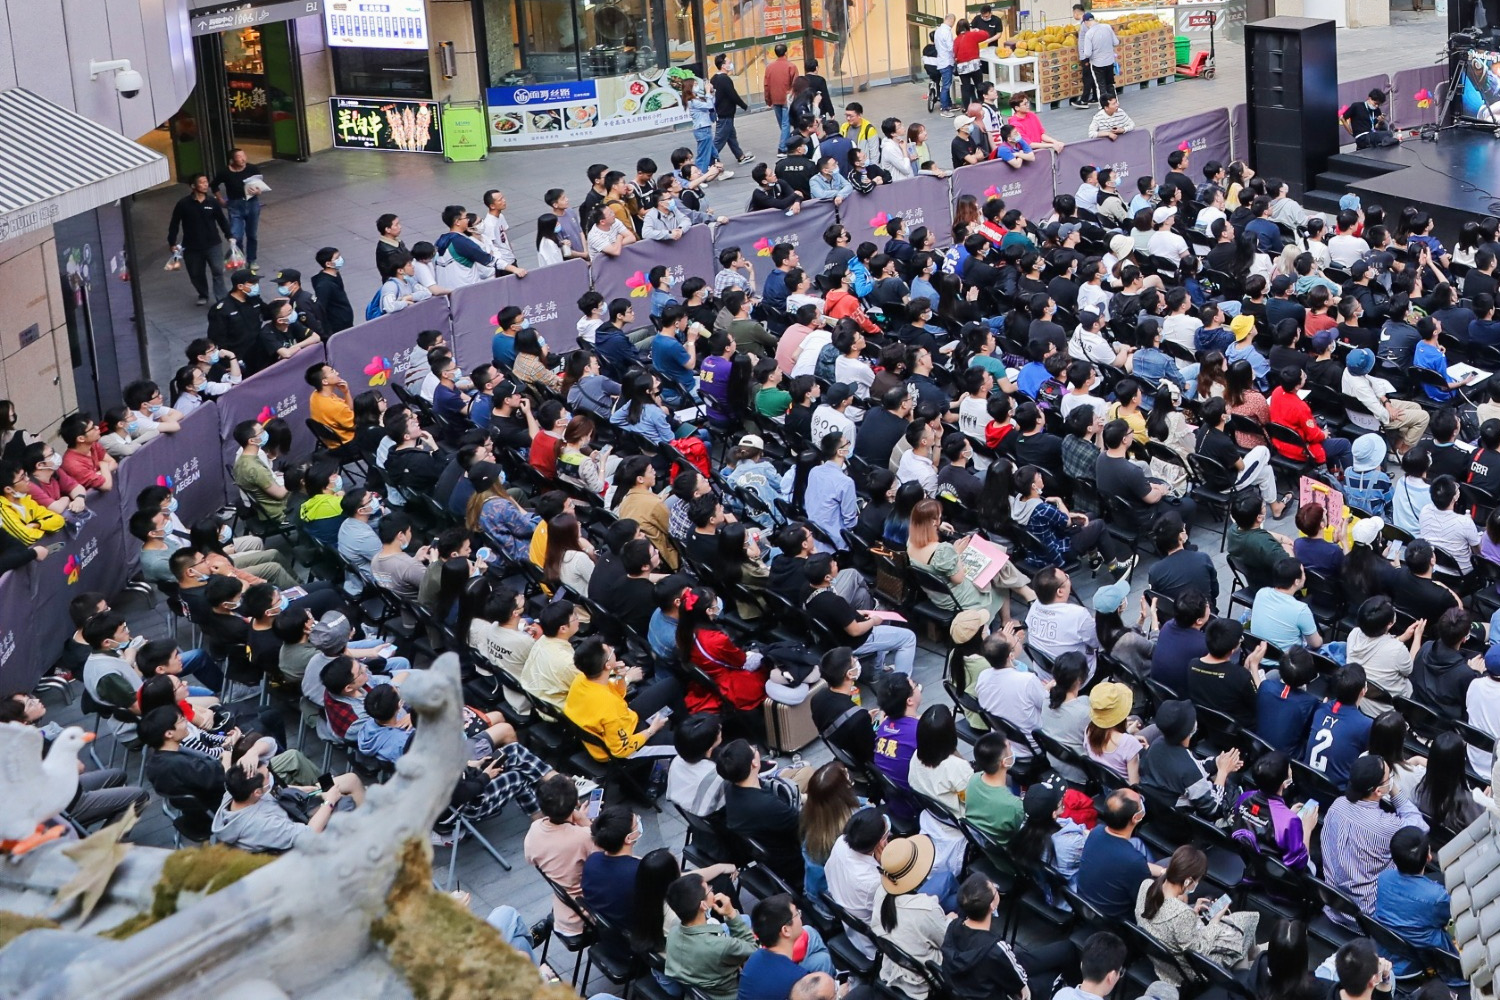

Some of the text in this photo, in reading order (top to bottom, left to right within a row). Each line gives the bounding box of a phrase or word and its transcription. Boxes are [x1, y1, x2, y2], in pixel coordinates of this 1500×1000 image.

[338, 109, 384, 147] 羊肉串
[1001, 181, 1021, 192] 爱琴海
[1002, 189, 1022, 198] AEGEAN
[276, 394, 297, 412] 爱琴海
[277, 403, 298, 418] AEGEAN
[174, 456, 199, 483] 爱琴海
[1470, 461, 1489, 477] GBR
[175, 470, 201, 495] AEGEAN
[80, 536, 98, 561] 爱琴海
[81, 547, 99, 570] AEGEAN
[1322, 715, 1339, 729] FY
[1309, 728, 1333, 773] 2
